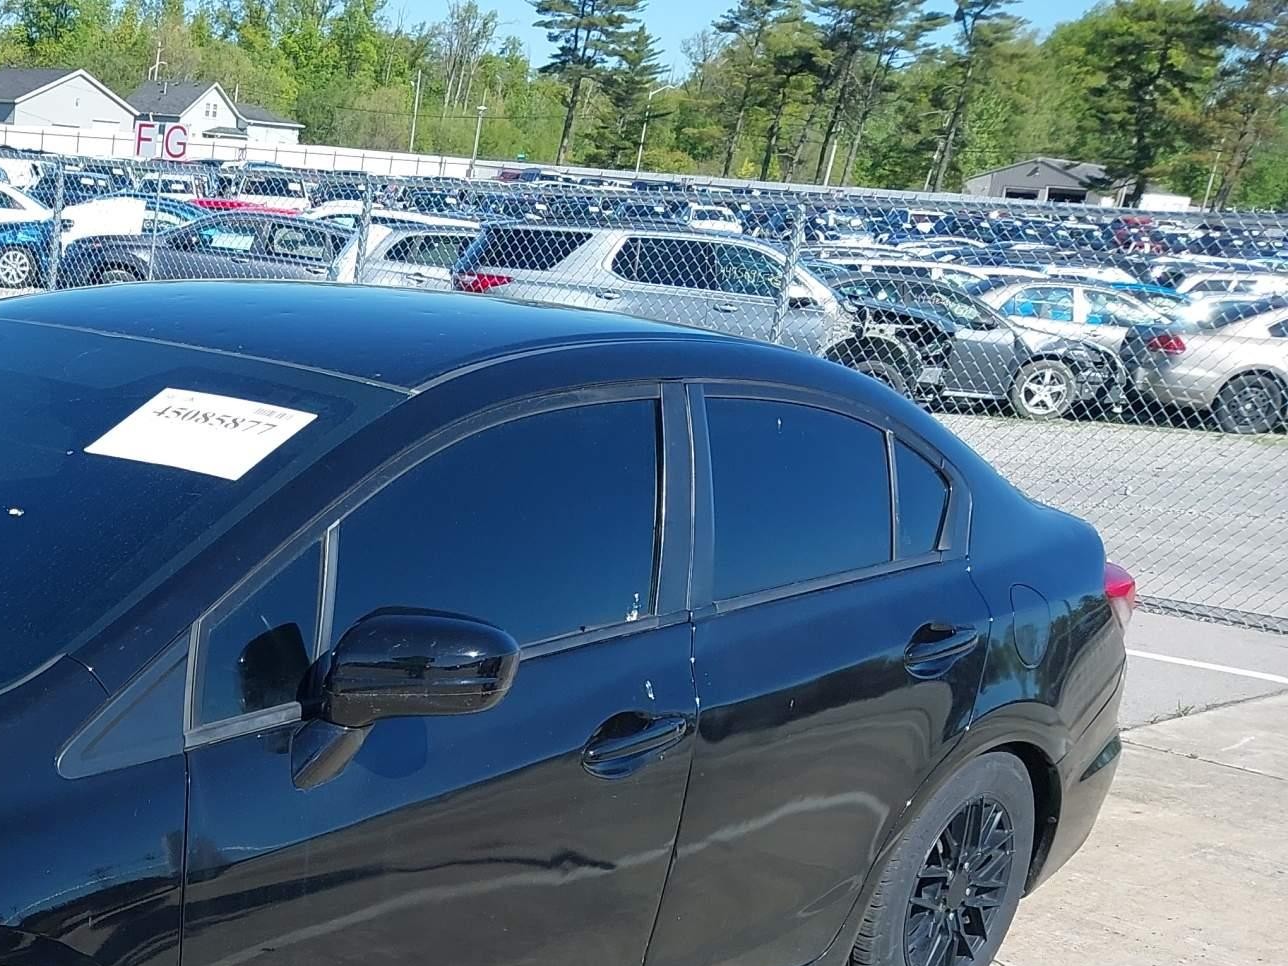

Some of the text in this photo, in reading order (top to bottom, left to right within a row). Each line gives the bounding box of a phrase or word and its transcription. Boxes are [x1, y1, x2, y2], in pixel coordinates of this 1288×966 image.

[136, 123, 155, 156] F
[165, 125, 188, 158] G
[152, 405, 278, 435] 45085877
